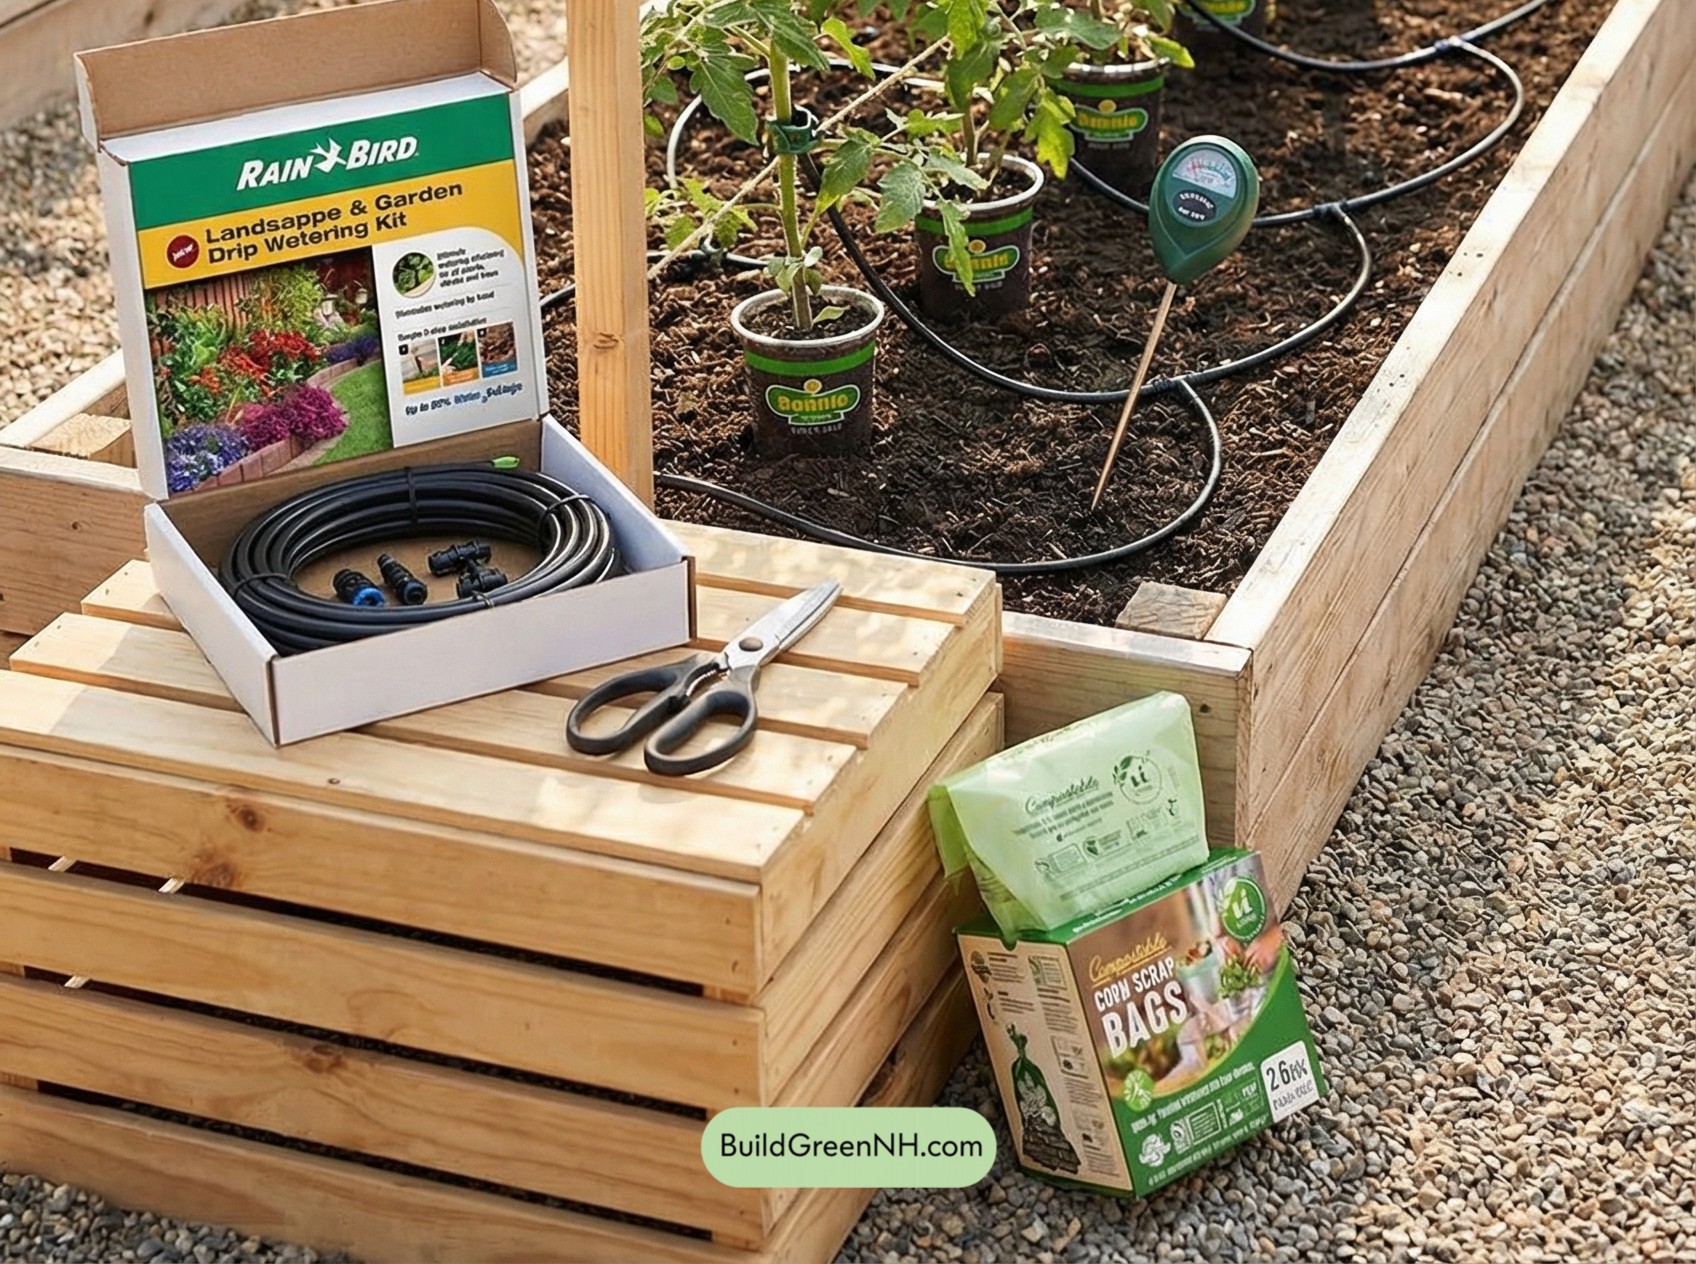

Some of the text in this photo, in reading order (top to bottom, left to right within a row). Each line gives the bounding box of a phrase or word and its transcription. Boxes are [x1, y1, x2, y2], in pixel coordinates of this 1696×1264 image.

[236, 136, 418, 191] RAIN BIRD
[205, 183, 463, 243] Landsappe & Garden
[208, 241, 258, 264] Drip
[375, 211, 407, 231] Kit
[1132, 956, 1175, 993] SCRAP
[1102, 981, 1188, 1059] BAGS
